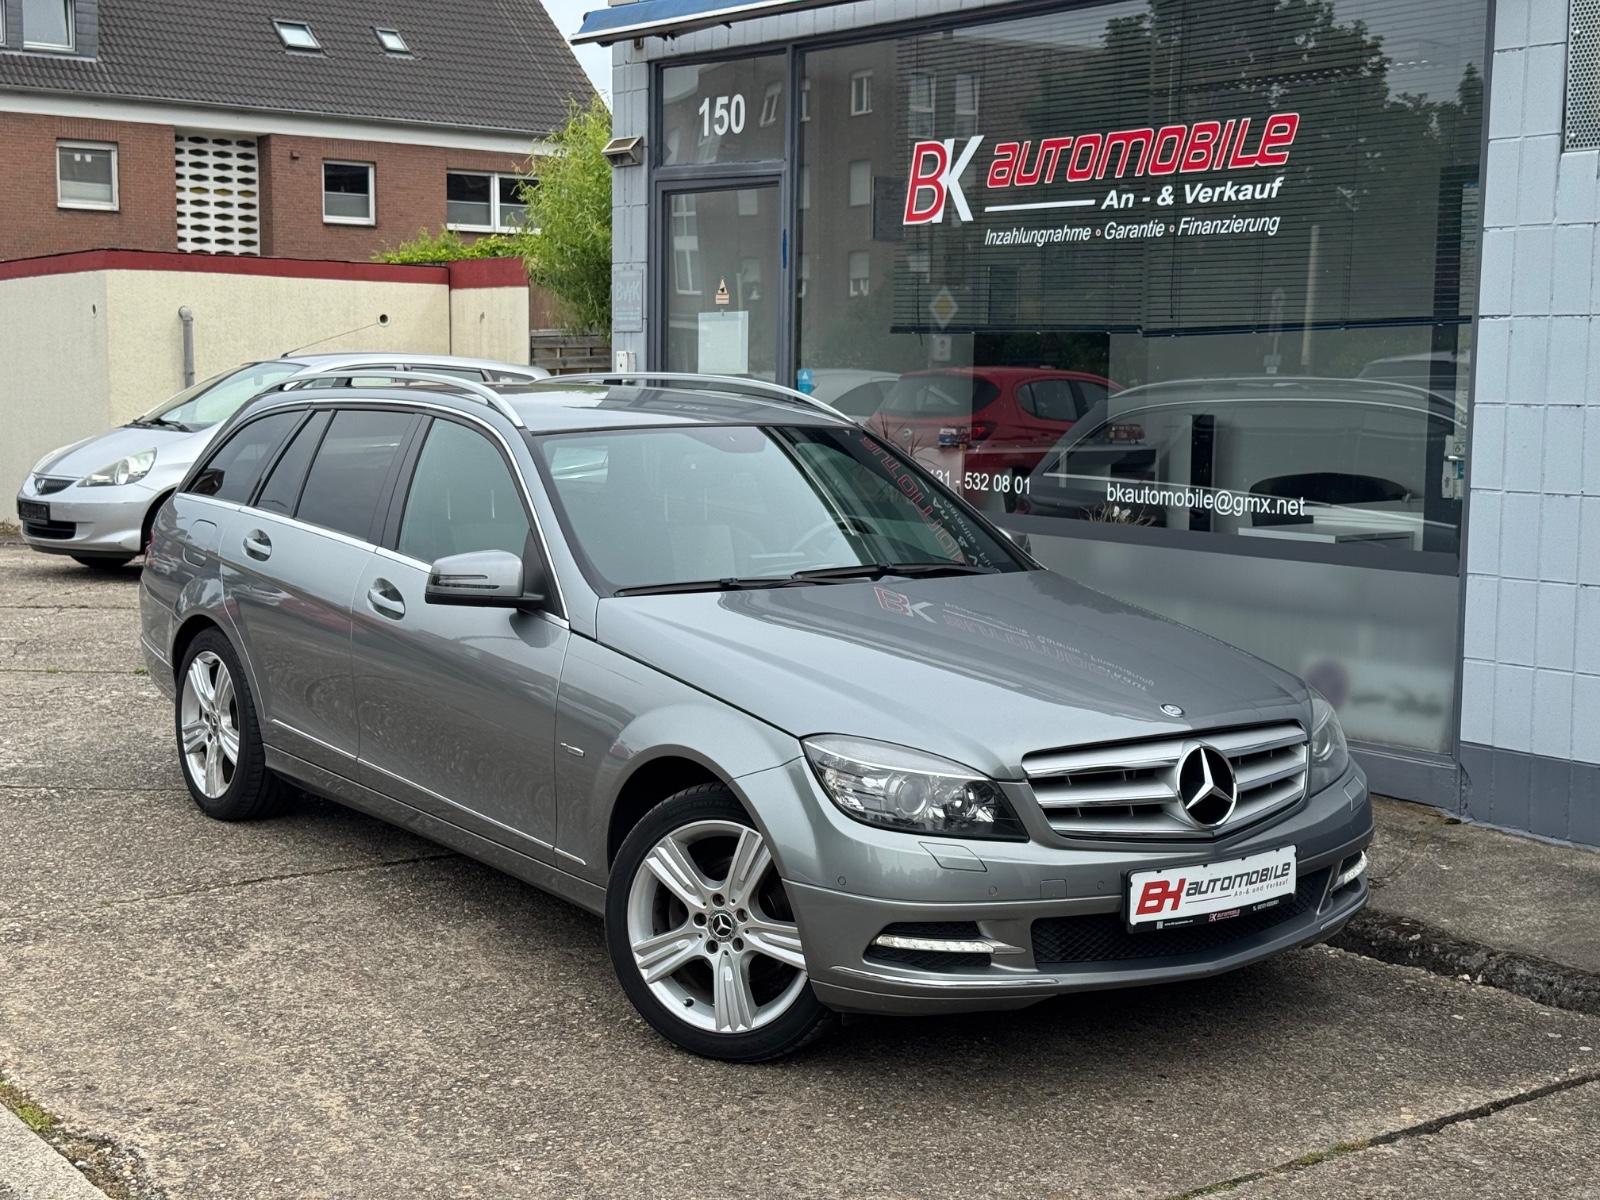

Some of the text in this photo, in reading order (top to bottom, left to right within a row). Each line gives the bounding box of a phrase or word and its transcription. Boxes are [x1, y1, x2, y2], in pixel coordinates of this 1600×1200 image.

[698, 94, 746, 137] 150
[903, 135, 985, 225] BK
[1101, 190, 1134, 210] An
[1157, 185, 1174, 206] &
[1185, 177, 1285, 204] Verkauf
[984, 214, 1280, 247] Inzahlungnahme Garantie Finanzierung
[964, 472, 989, 491] 532
[993, 474, 1010, 493] 08
[1014, 476, 1030, 495] 01
[1106, 482, 1306, 517] bkautomobile@gmx.net
